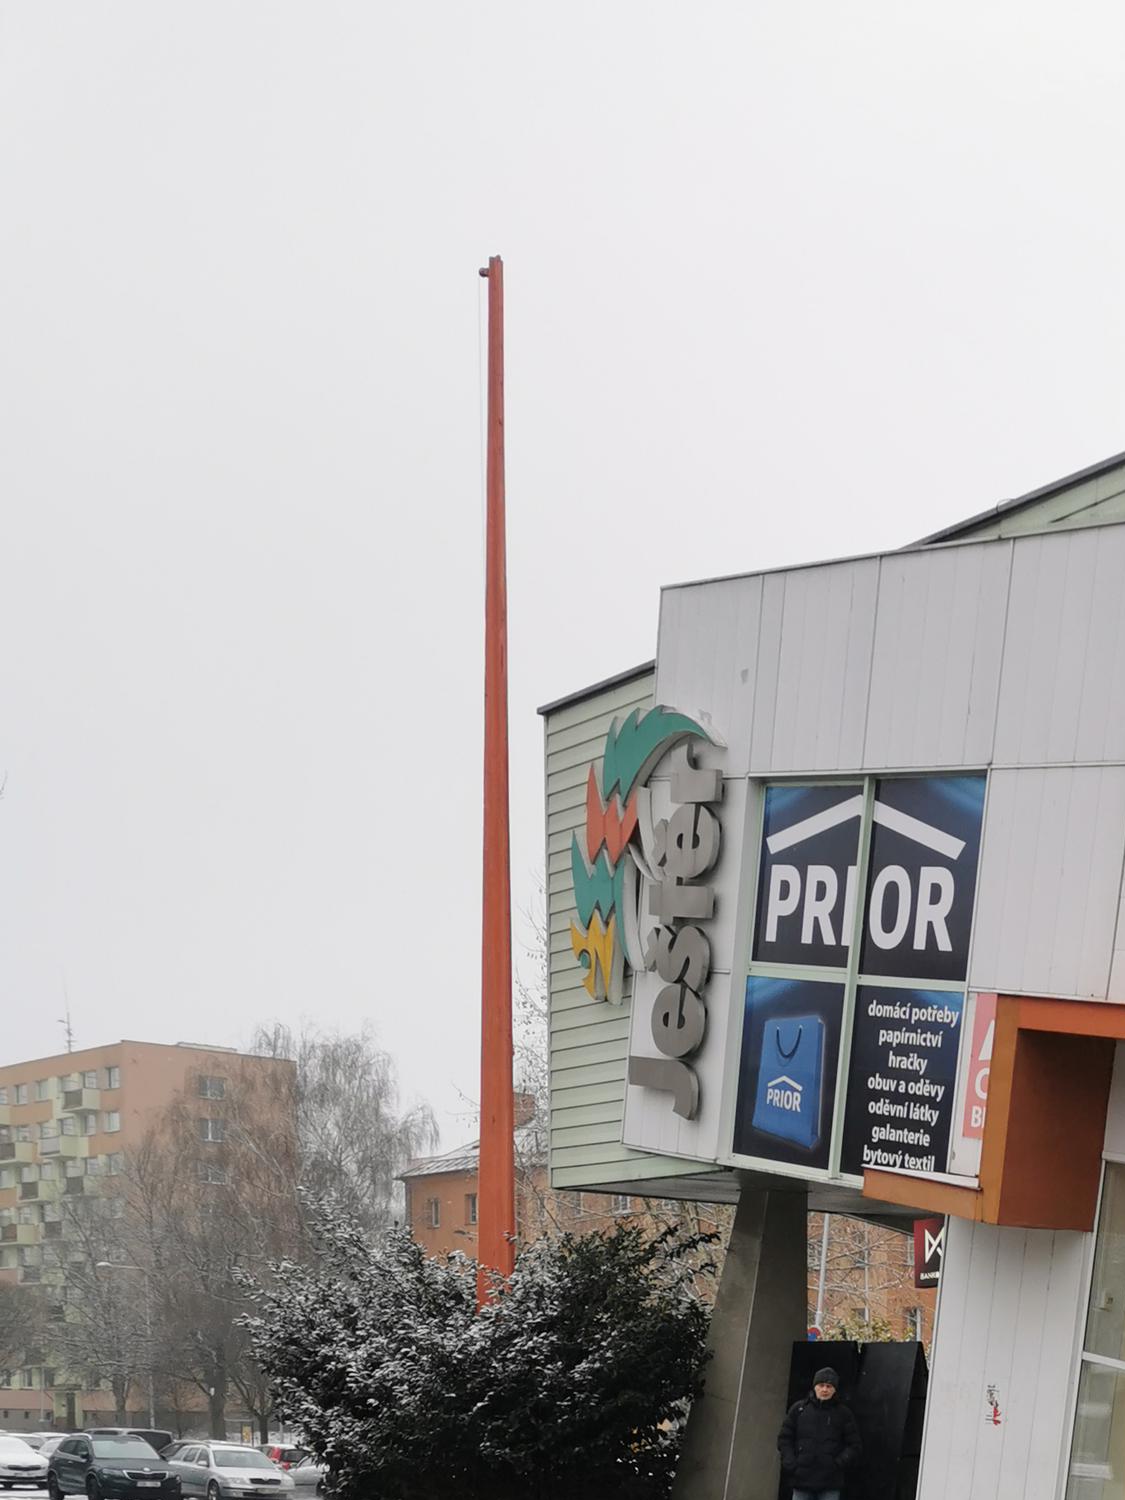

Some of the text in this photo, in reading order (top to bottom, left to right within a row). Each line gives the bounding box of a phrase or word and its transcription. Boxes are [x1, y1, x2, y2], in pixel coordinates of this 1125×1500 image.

[765, 864, 954, 952] PRIOR
[868, 1000, 960, 1028] domácí potřeby
[878, 1027, 944, 1048] papírnictví
[888, 1051, 928, 1075] hračky
[766, 1088, 801, 1113] PRIOR
[867, 1073, 945, 1102] obuv a oděvy
[868, 1098, 939, 1126] oděvní látky
[871, 1123, 931, 1147] galanterie
[863, 1144, 935, 1172] bytový textil
